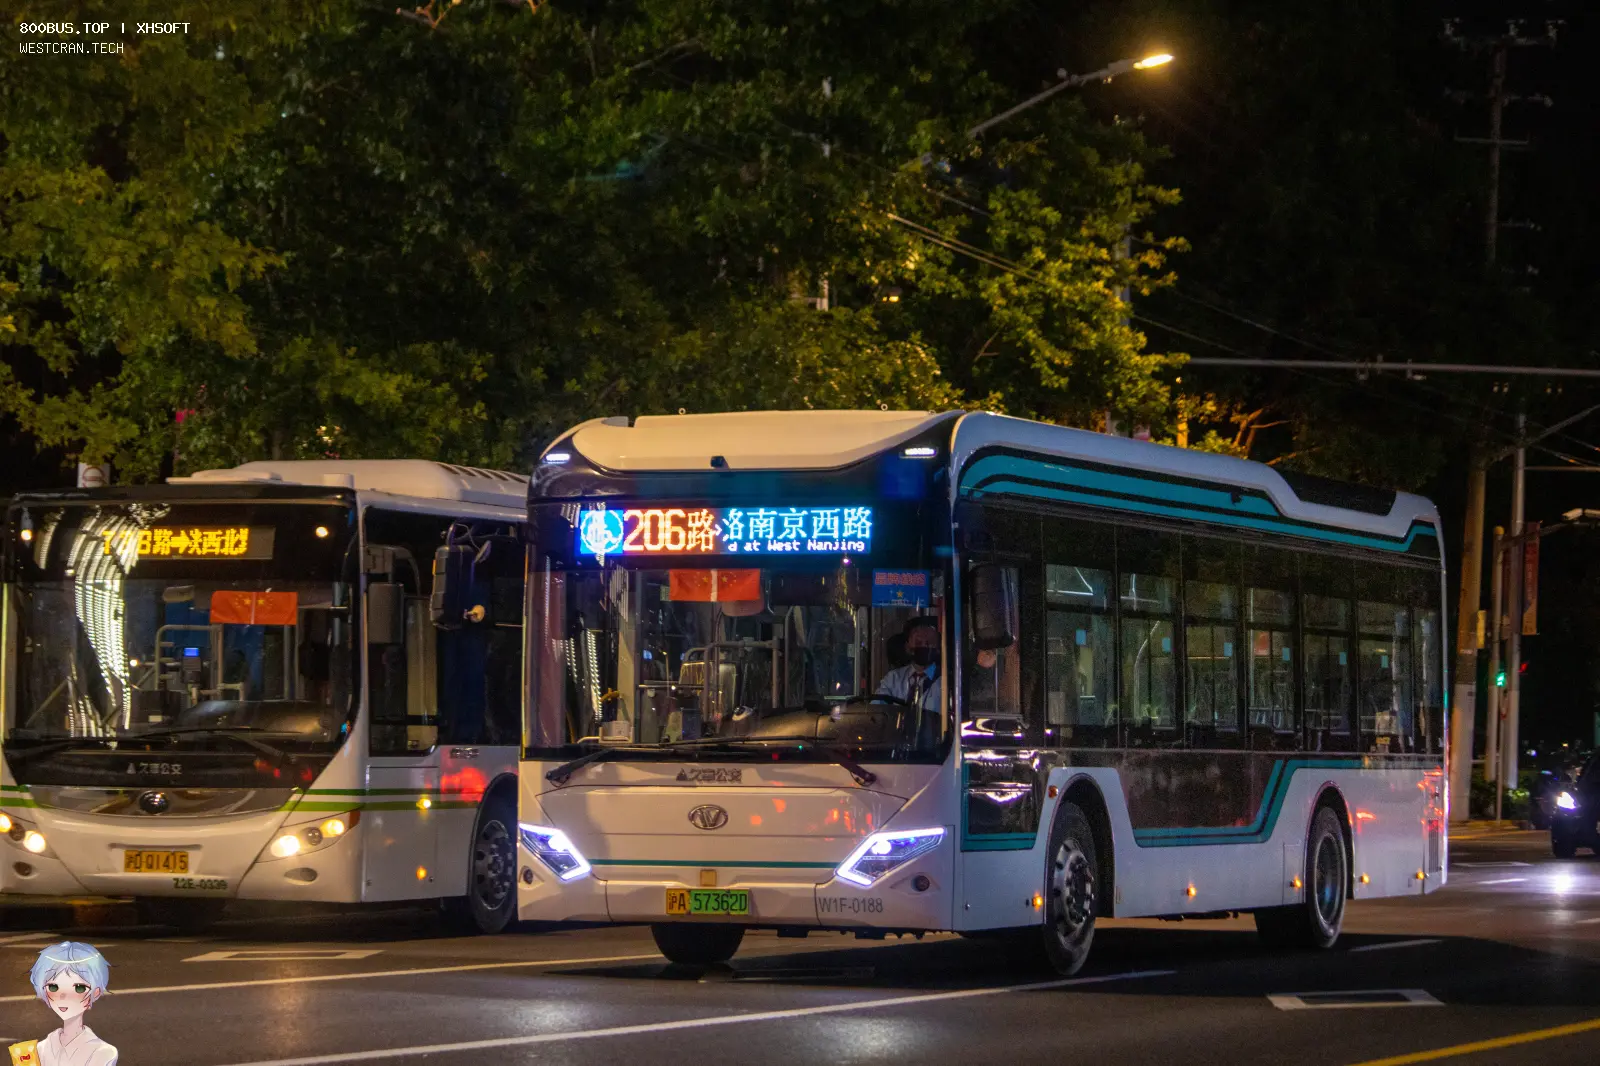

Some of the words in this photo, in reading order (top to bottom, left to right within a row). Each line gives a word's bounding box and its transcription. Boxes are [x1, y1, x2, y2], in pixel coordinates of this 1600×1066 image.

[623, 509, 715, 552] 206路
[743, 540, 761, 552] at
[767, 540, 800, 552] West
[807, 539, 866, 552] Nanjing
[818, 897, 884, 914] W1F-0188
